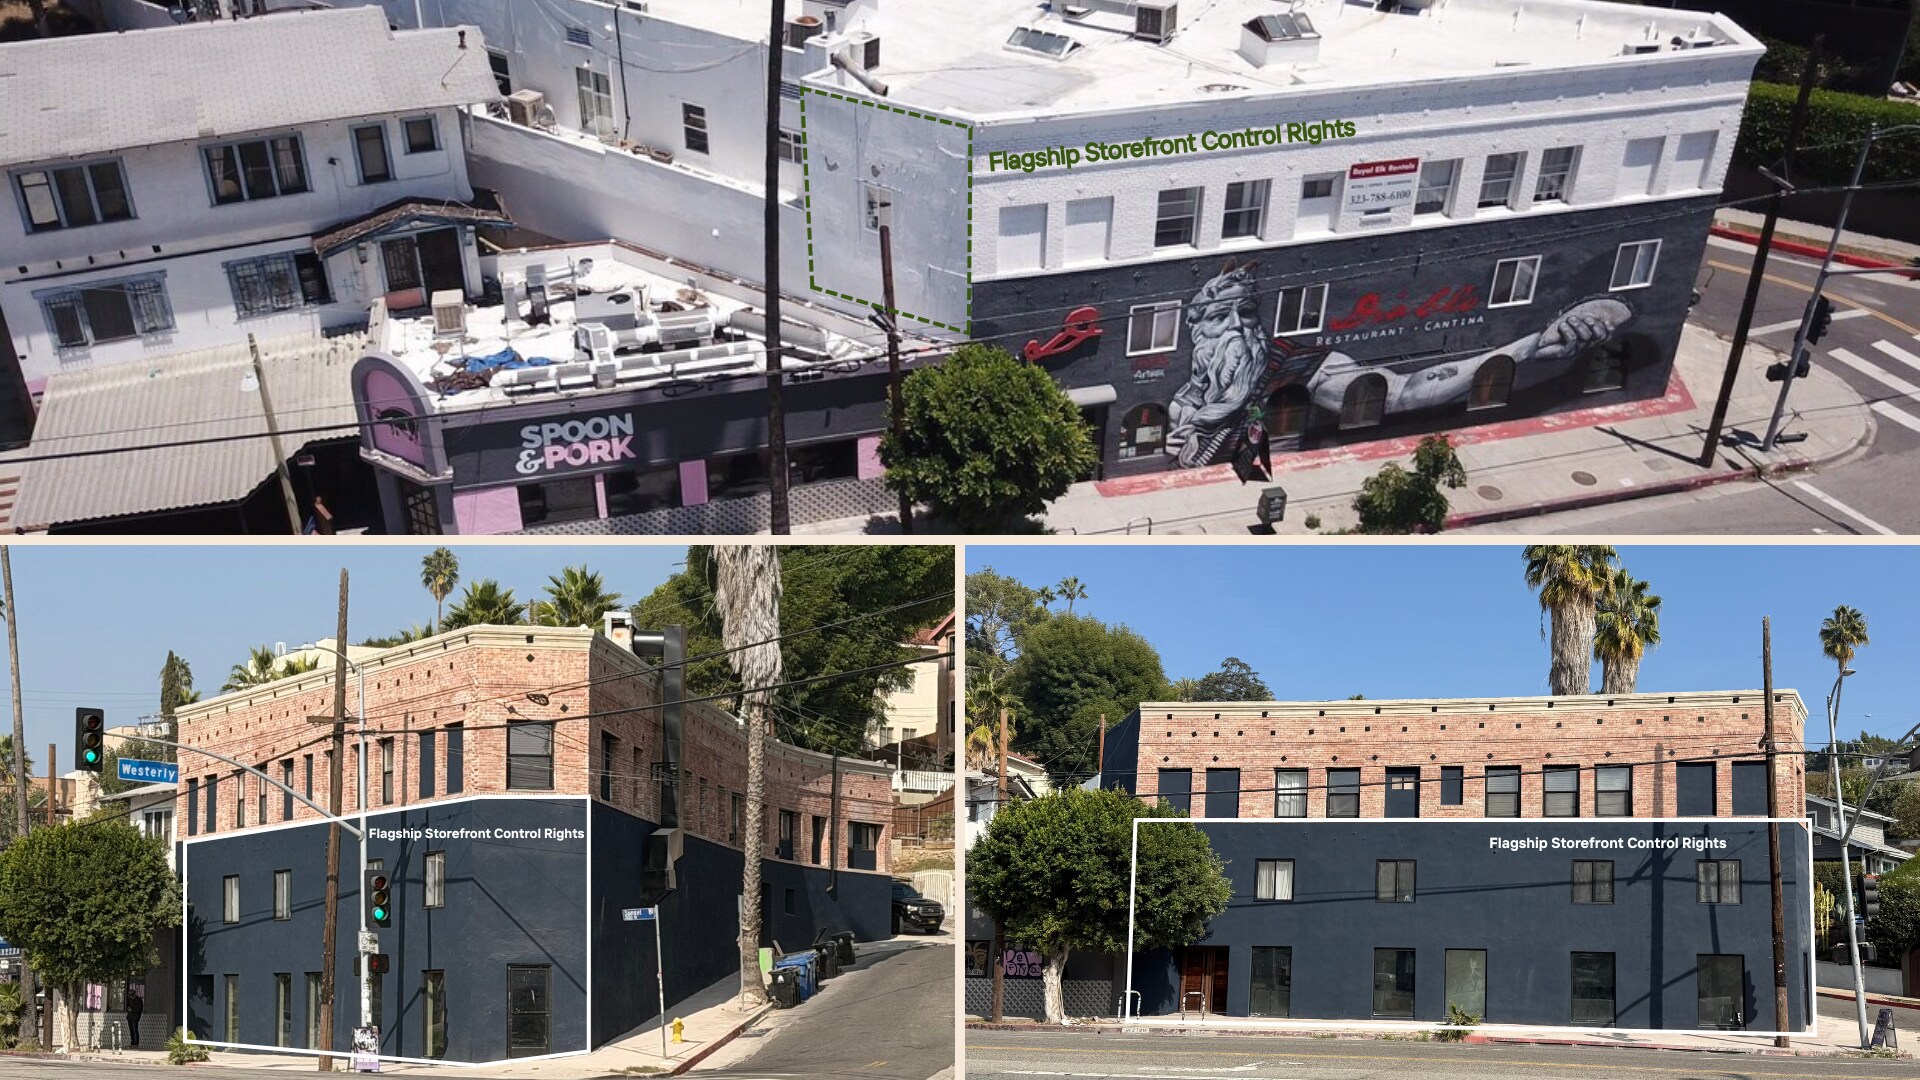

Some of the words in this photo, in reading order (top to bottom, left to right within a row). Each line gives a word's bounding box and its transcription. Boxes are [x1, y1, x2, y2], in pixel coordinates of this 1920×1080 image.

[1315, 326, 1405, 347] RESTAURANT
[1424, 315, 1485, 332] CANTINA
[521, 413, 634, 449] SPOON
[121, 763, 176, 782] Westerly
